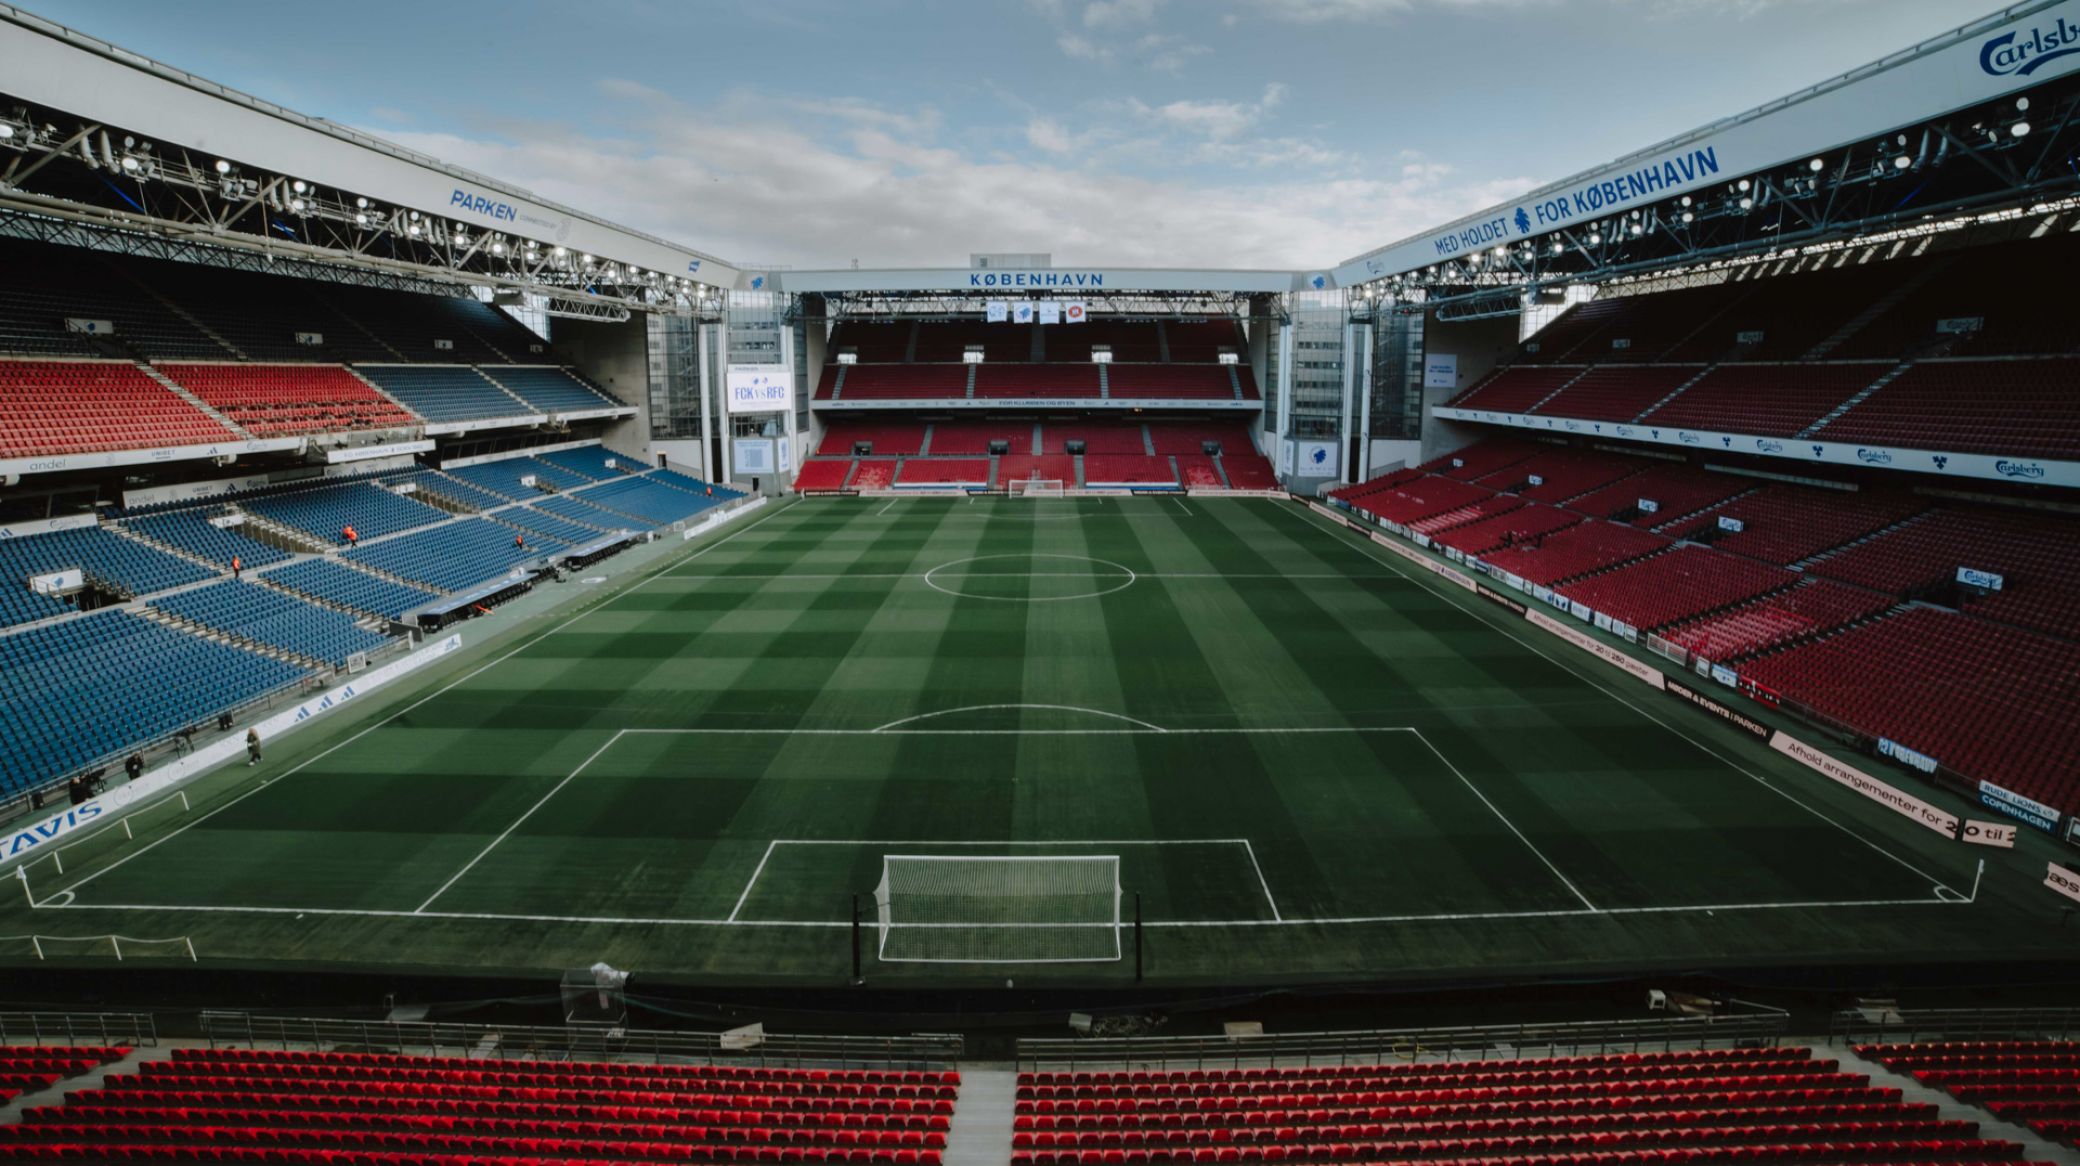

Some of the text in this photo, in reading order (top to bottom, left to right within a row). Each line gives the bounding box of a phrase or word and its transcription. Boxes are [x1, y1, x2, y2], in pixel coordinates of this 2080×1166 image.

[450, 189, 518, 223] PARKEN
[1434, 146, 1720, 257] MED HOLDET FOR KØBENHAVN
[970, 273, 1102, 286] KØBENHAVN
[735, 386, 753, 401] FCK
[767, 385, 785, 400] RFC
[29, 458, 67, 471] andel
[1857, 448, 1892, 465] Carlsberg
[1995, 460, 2045, 480] Carlsberg
[1733, 714, 1767, 737] PARKEN
[1788, 742, 1822, 768] Afhold
[1822, 763, 1919, 814] arrangementer
[1920, 809, 1942, 826] for
[1983, 783, 2010, 800] RUDE
[1981, 794, 2052, 831] COPENHAGEN
[1985, 829, 2003, 841] til
